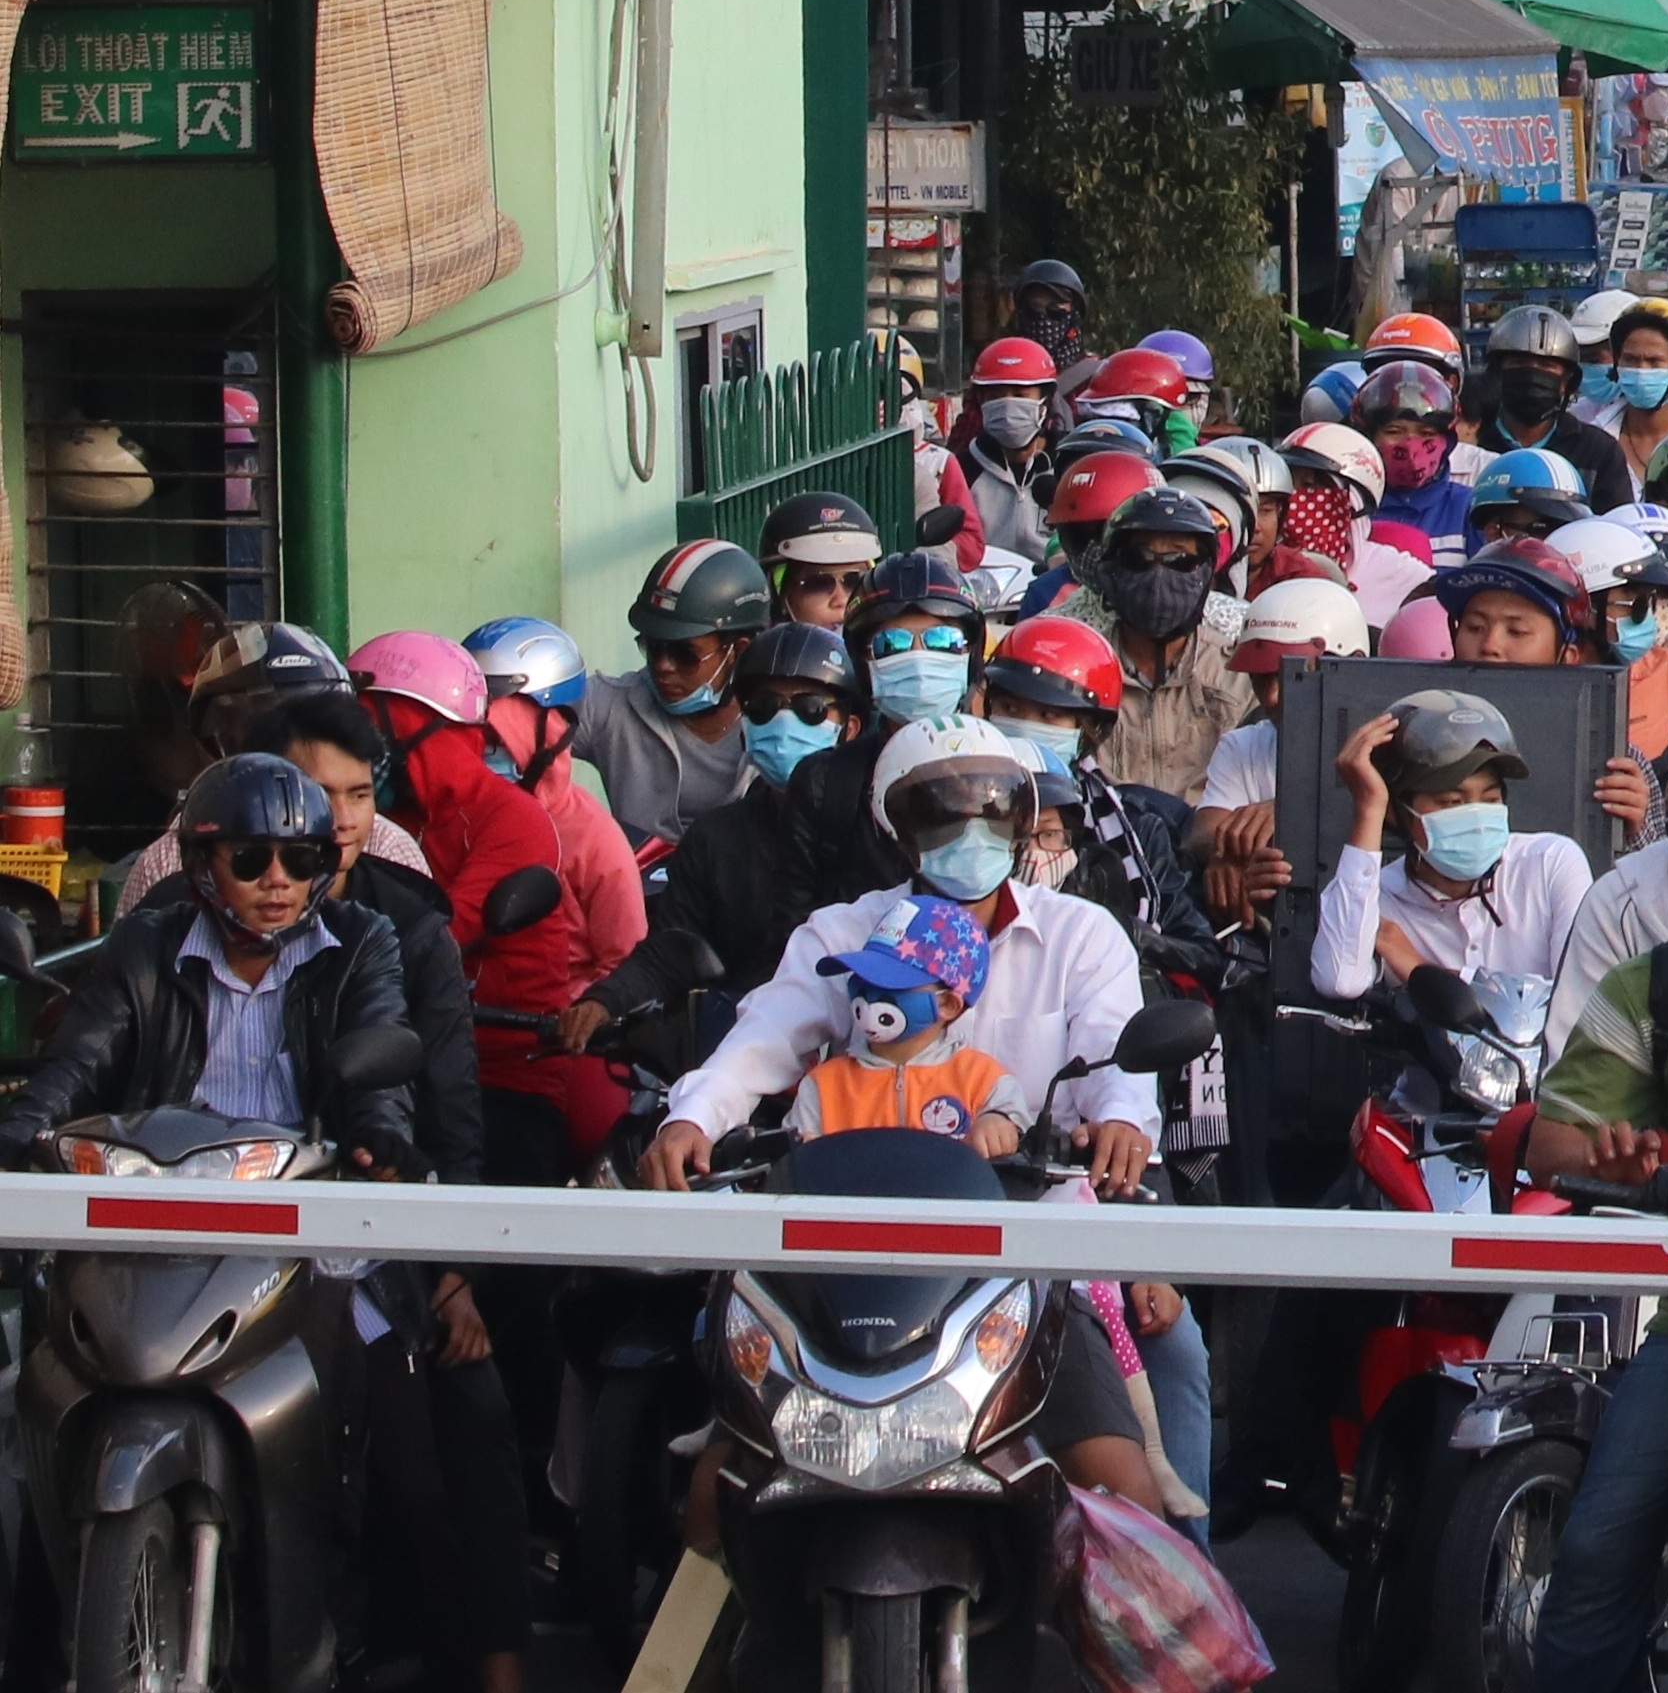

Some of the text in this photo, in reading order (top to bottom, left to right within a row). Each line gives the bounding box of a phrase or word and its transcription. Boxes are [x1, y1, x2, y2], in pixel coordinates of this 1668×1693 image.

[43, 82, 154, 126] EXIT
[936, 185, 969, 200] MOBILE
[251, 1268, 283, 1309] 110
[841, 1317, 897, 1328] HONDA
